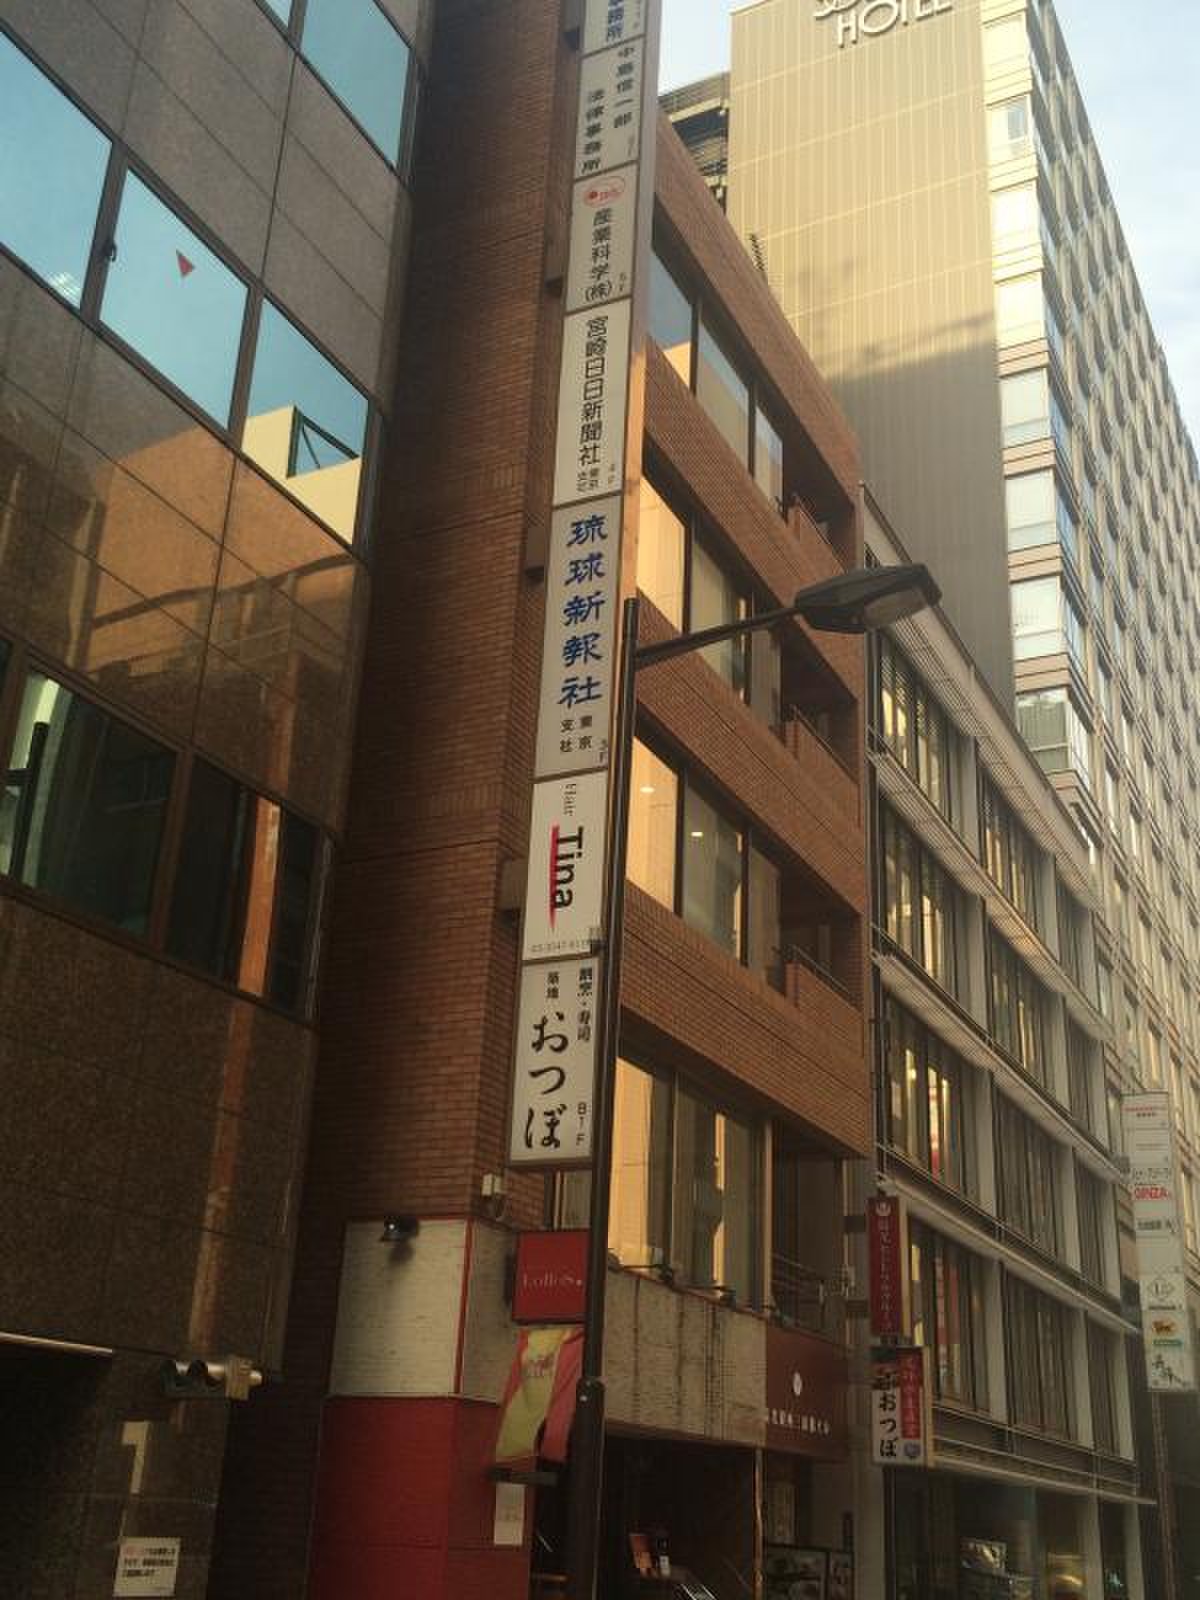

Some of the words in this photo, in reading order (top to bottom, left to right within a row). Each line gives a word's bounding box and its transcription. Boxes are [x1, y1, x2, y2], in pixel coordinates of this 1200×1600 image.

[577, 315, 609, 466] 宮崎日日新聞社
[557, 514, 608, 710] 琉球新報社
[552, 825, 584, 910] Tina
[524, 1010, 570, 1149] おつぼ
[878, 1395, 900, 1459] おつぼ
